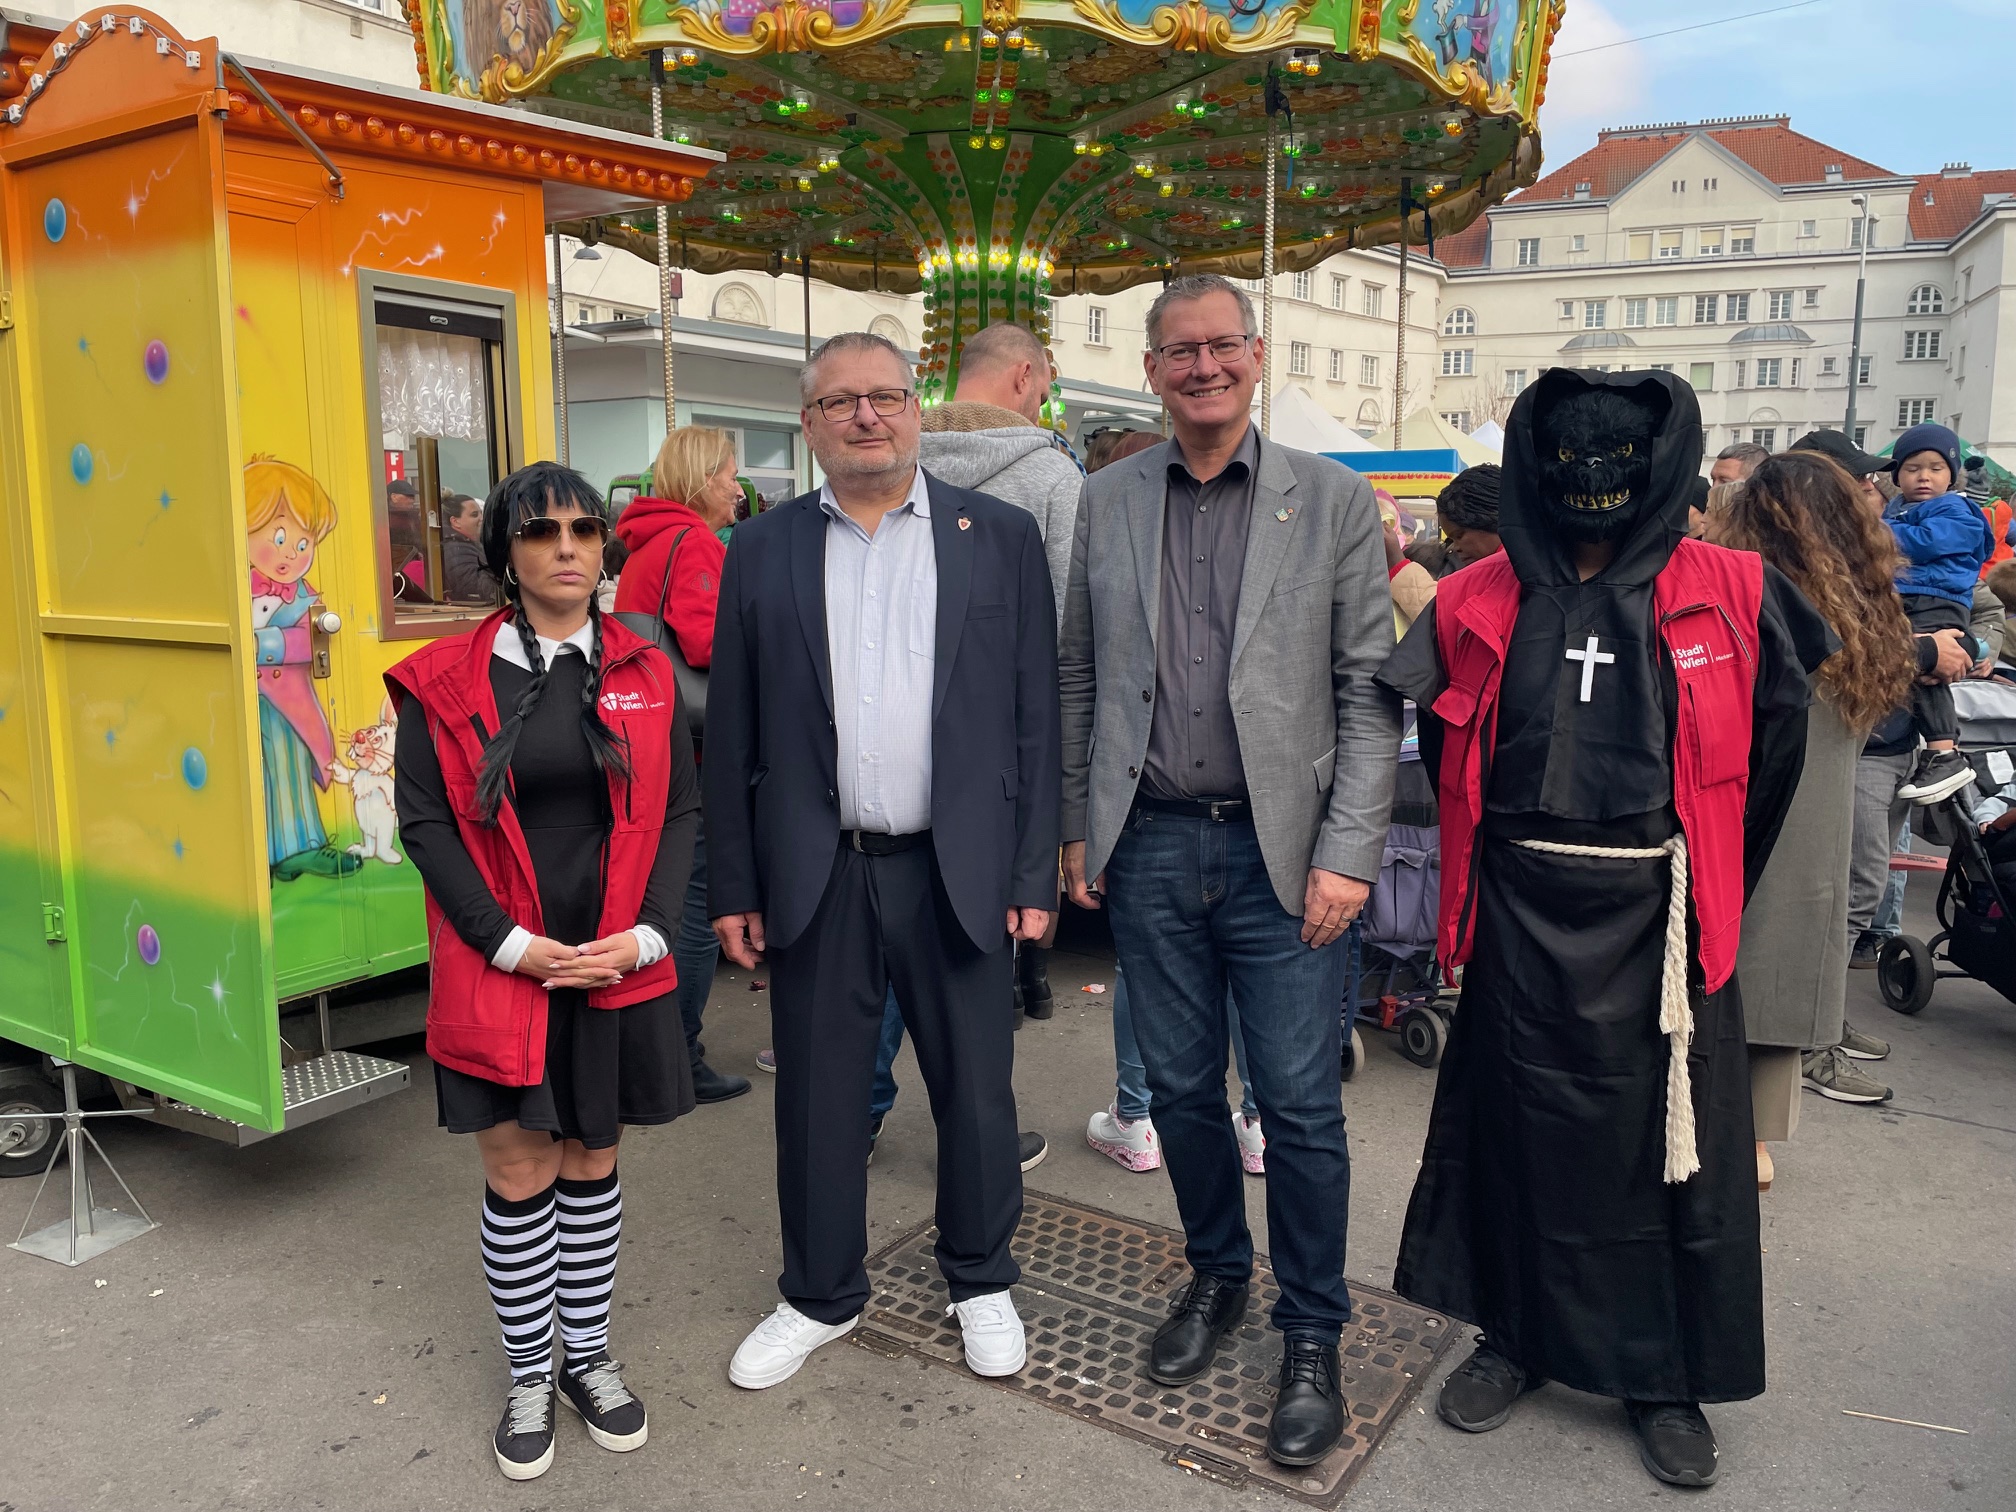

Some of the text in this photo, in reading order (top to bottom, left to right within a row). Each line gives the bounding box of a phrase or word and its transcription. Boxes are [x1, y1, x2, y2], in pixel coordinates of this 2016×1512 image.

[1676, 643, 1704, 659] Stadt
[1679, 656, 1708, 670] Wien
[616, 691, 640, 702] Stadt
[619, 701, 644, 711] Wien
[874, 1279, 904, 1293] 124
